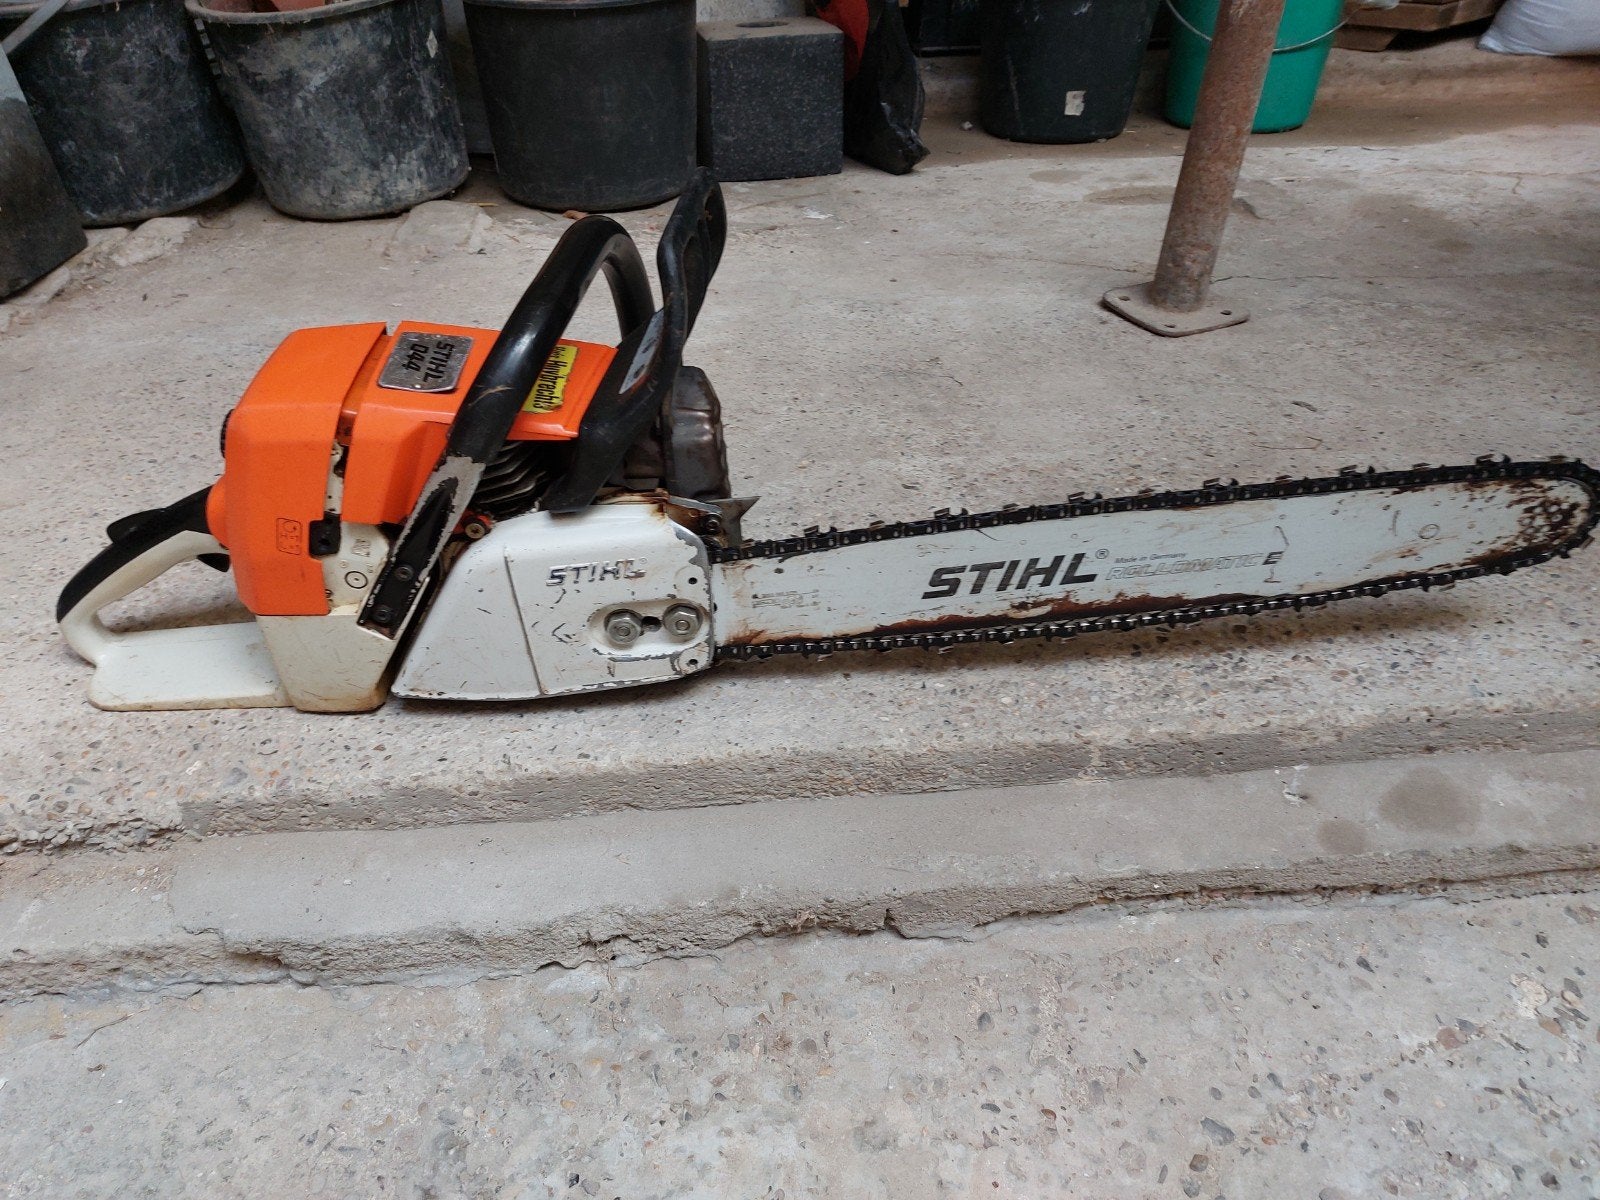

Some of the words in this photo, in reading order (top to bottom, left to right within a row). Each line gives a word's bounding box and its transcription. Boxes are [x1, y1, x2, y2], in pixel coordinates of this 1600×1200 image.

[401, 343, 429, 372] 044
[423, 341, 455, 382] STIHL
[546, 558, 647, 586] STIHL
[1262, 550, 1285, 566] E
[921, 552, 1098, 599] STIHL
